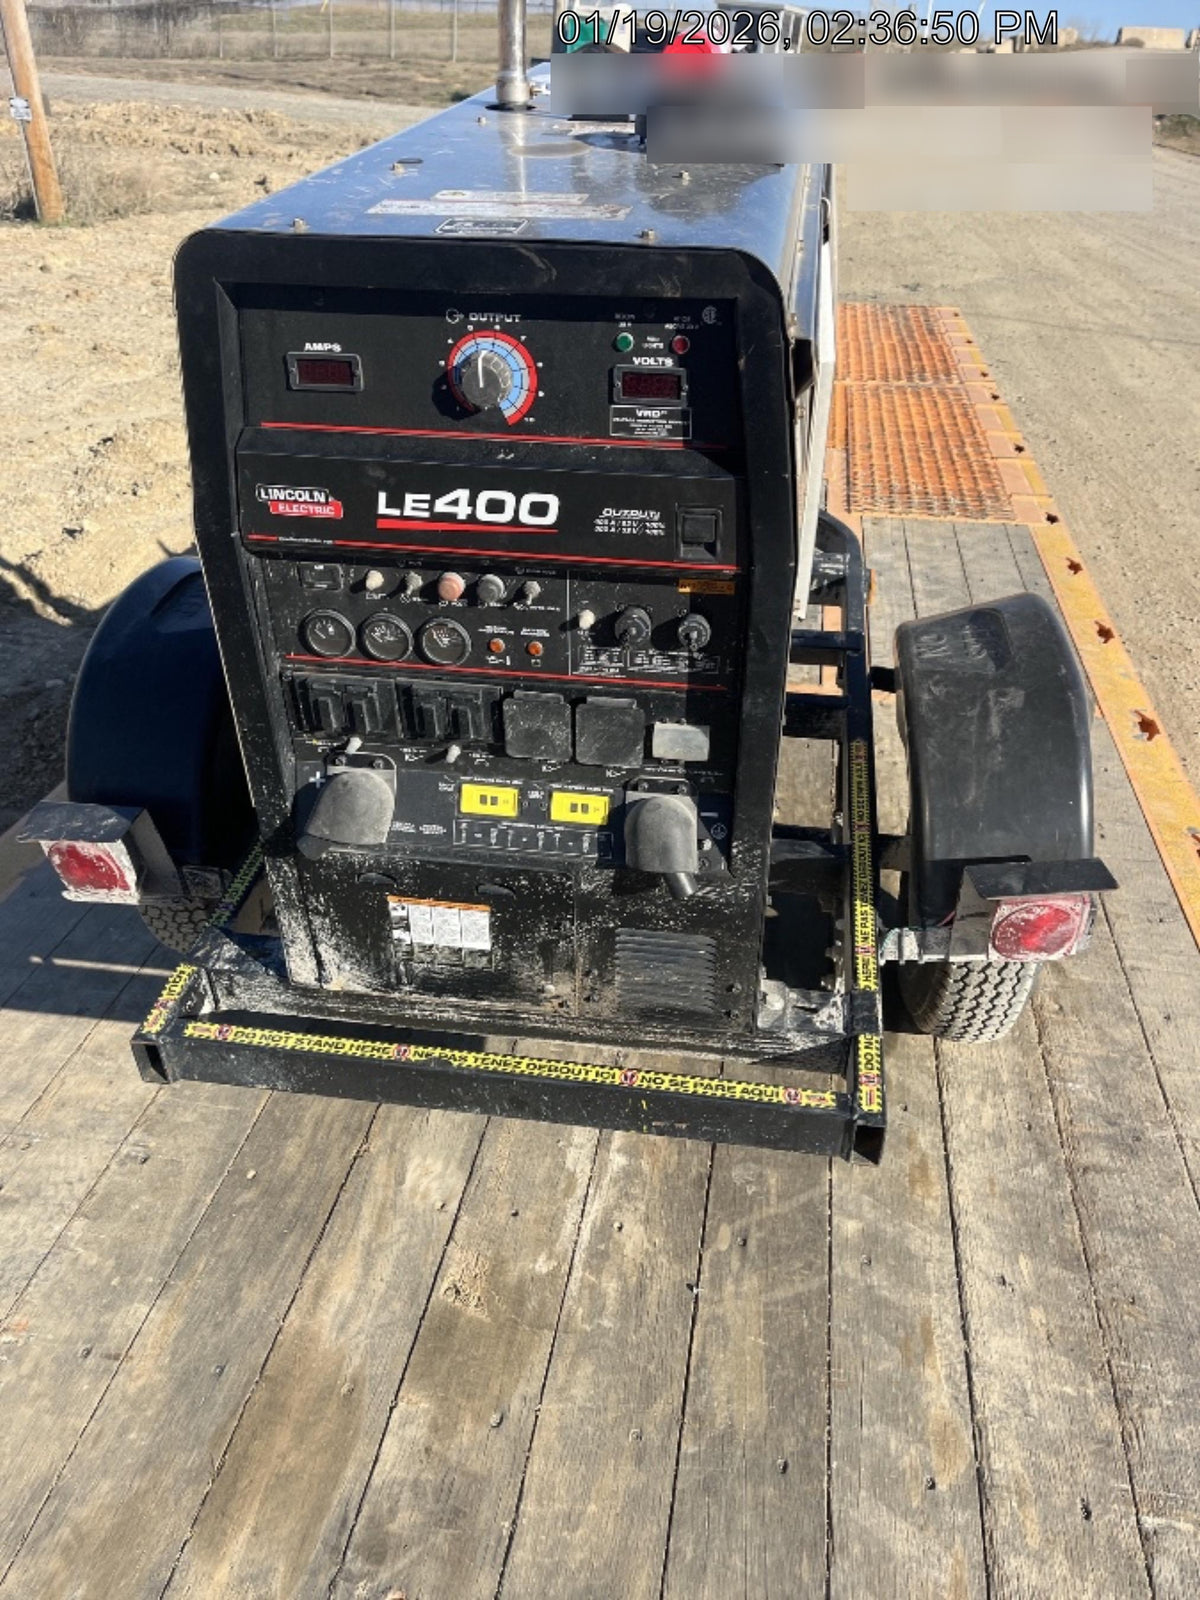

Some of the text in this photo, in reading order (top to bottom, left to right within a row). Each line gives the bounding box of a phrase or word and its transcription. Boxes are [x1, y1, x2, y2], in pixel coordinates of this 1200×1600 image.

[469, 312, 522, 323] OUTPUT
[304, 342, 342, 353] AMPS
[632, 356, 674, 367] VOLTS
[260, 488, 326, 504] LINCOLN
[278, 504, 335, 515] ELECTRIC
[377, 488, 560, 526] LE400
[233, 1030, 391, 1056] DO NOT STAND HERE
[472, 1056, 522, 1069] TENEZ
[525, 1062, 592, 1077] DEBOUT
[594, 1069, 616, 1081] ICI
[863, 1052, 874, 1070] DO
[640, 1074, 780, 1099] NO SE PARE AQUI
